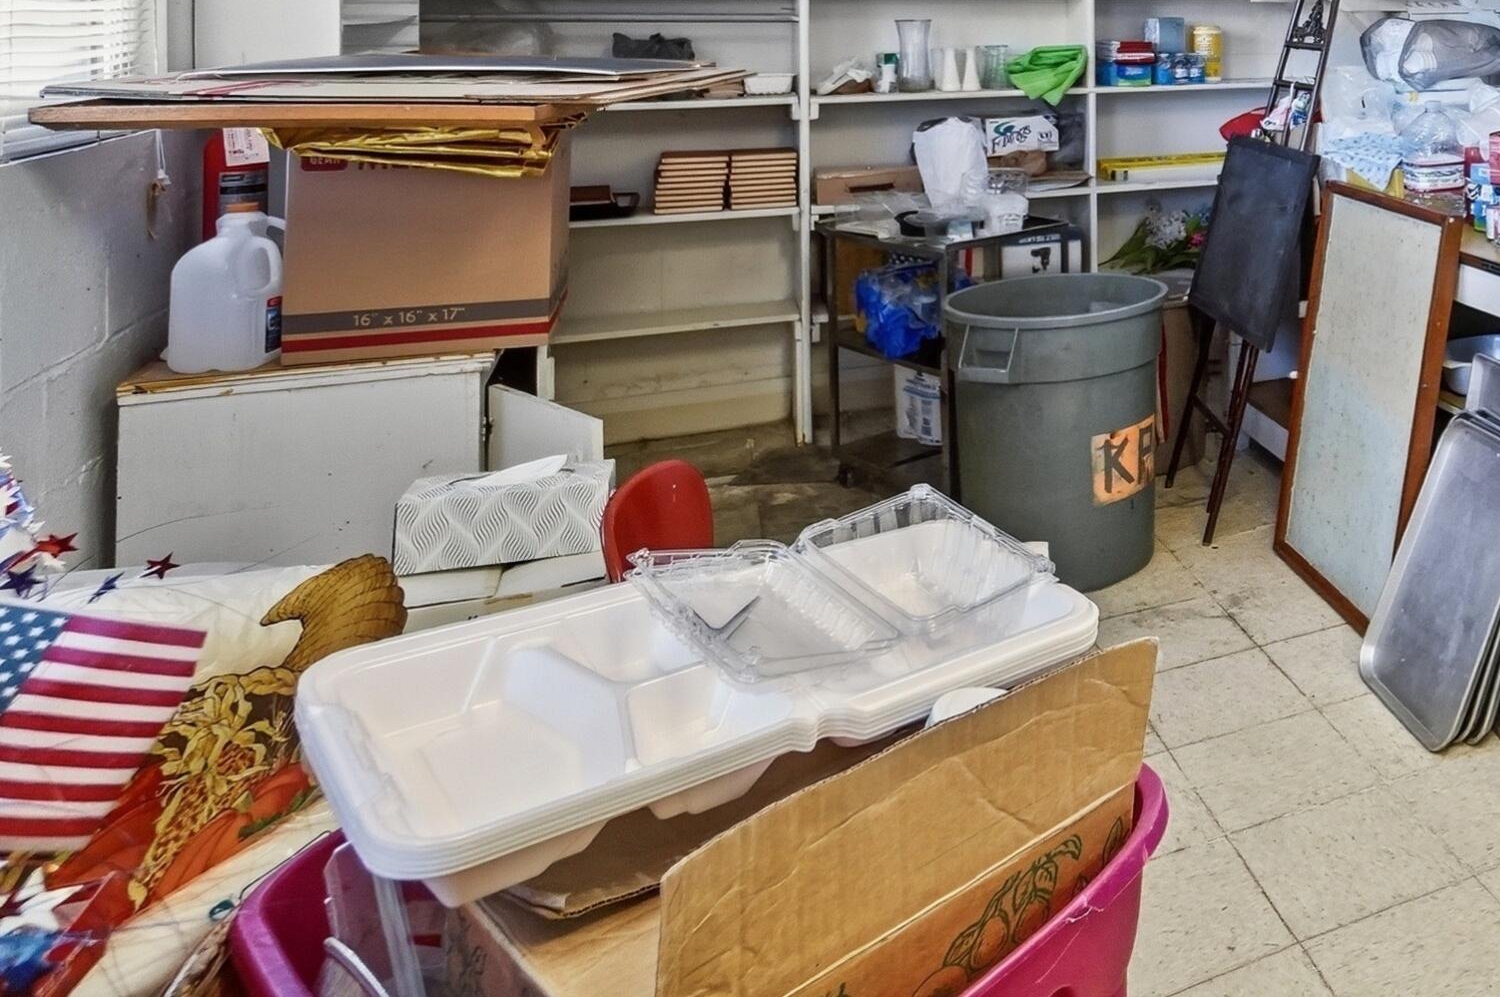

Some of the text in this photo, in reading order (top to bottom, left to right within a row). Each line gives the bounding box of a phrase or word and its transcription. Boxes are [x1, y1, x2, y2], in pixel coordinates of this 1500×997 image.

[353, 312, 379, 326] 16"
[383, 315, 394, 325] x
[399, 310, 423, 323] 16"
[428, 312, 438, 322] x
